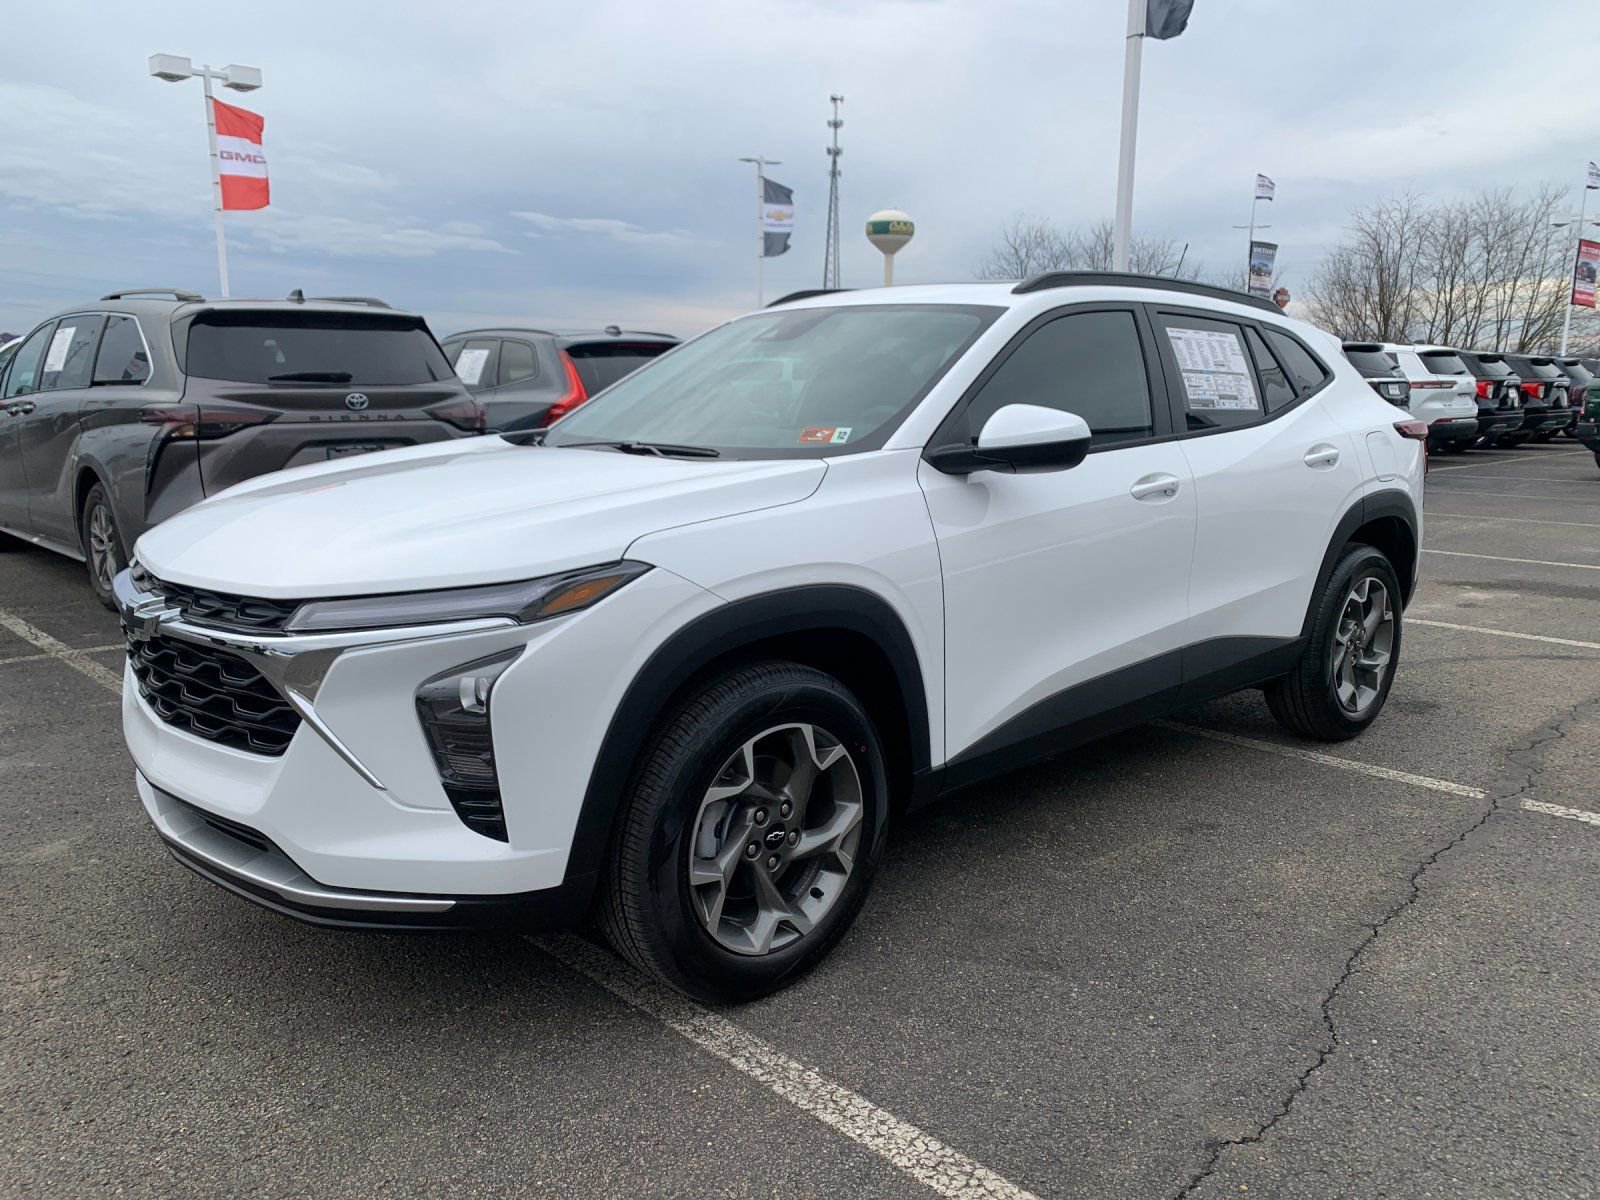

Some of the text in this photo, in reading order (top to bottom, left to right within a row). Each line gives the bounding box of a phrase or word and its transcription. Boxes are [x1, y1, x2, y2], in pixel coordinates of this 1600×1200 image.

[220, 150, 266, 164] GMC
[1253, 246, 1276, 256] VICTORY
[837, 431, 848, 440] 12
